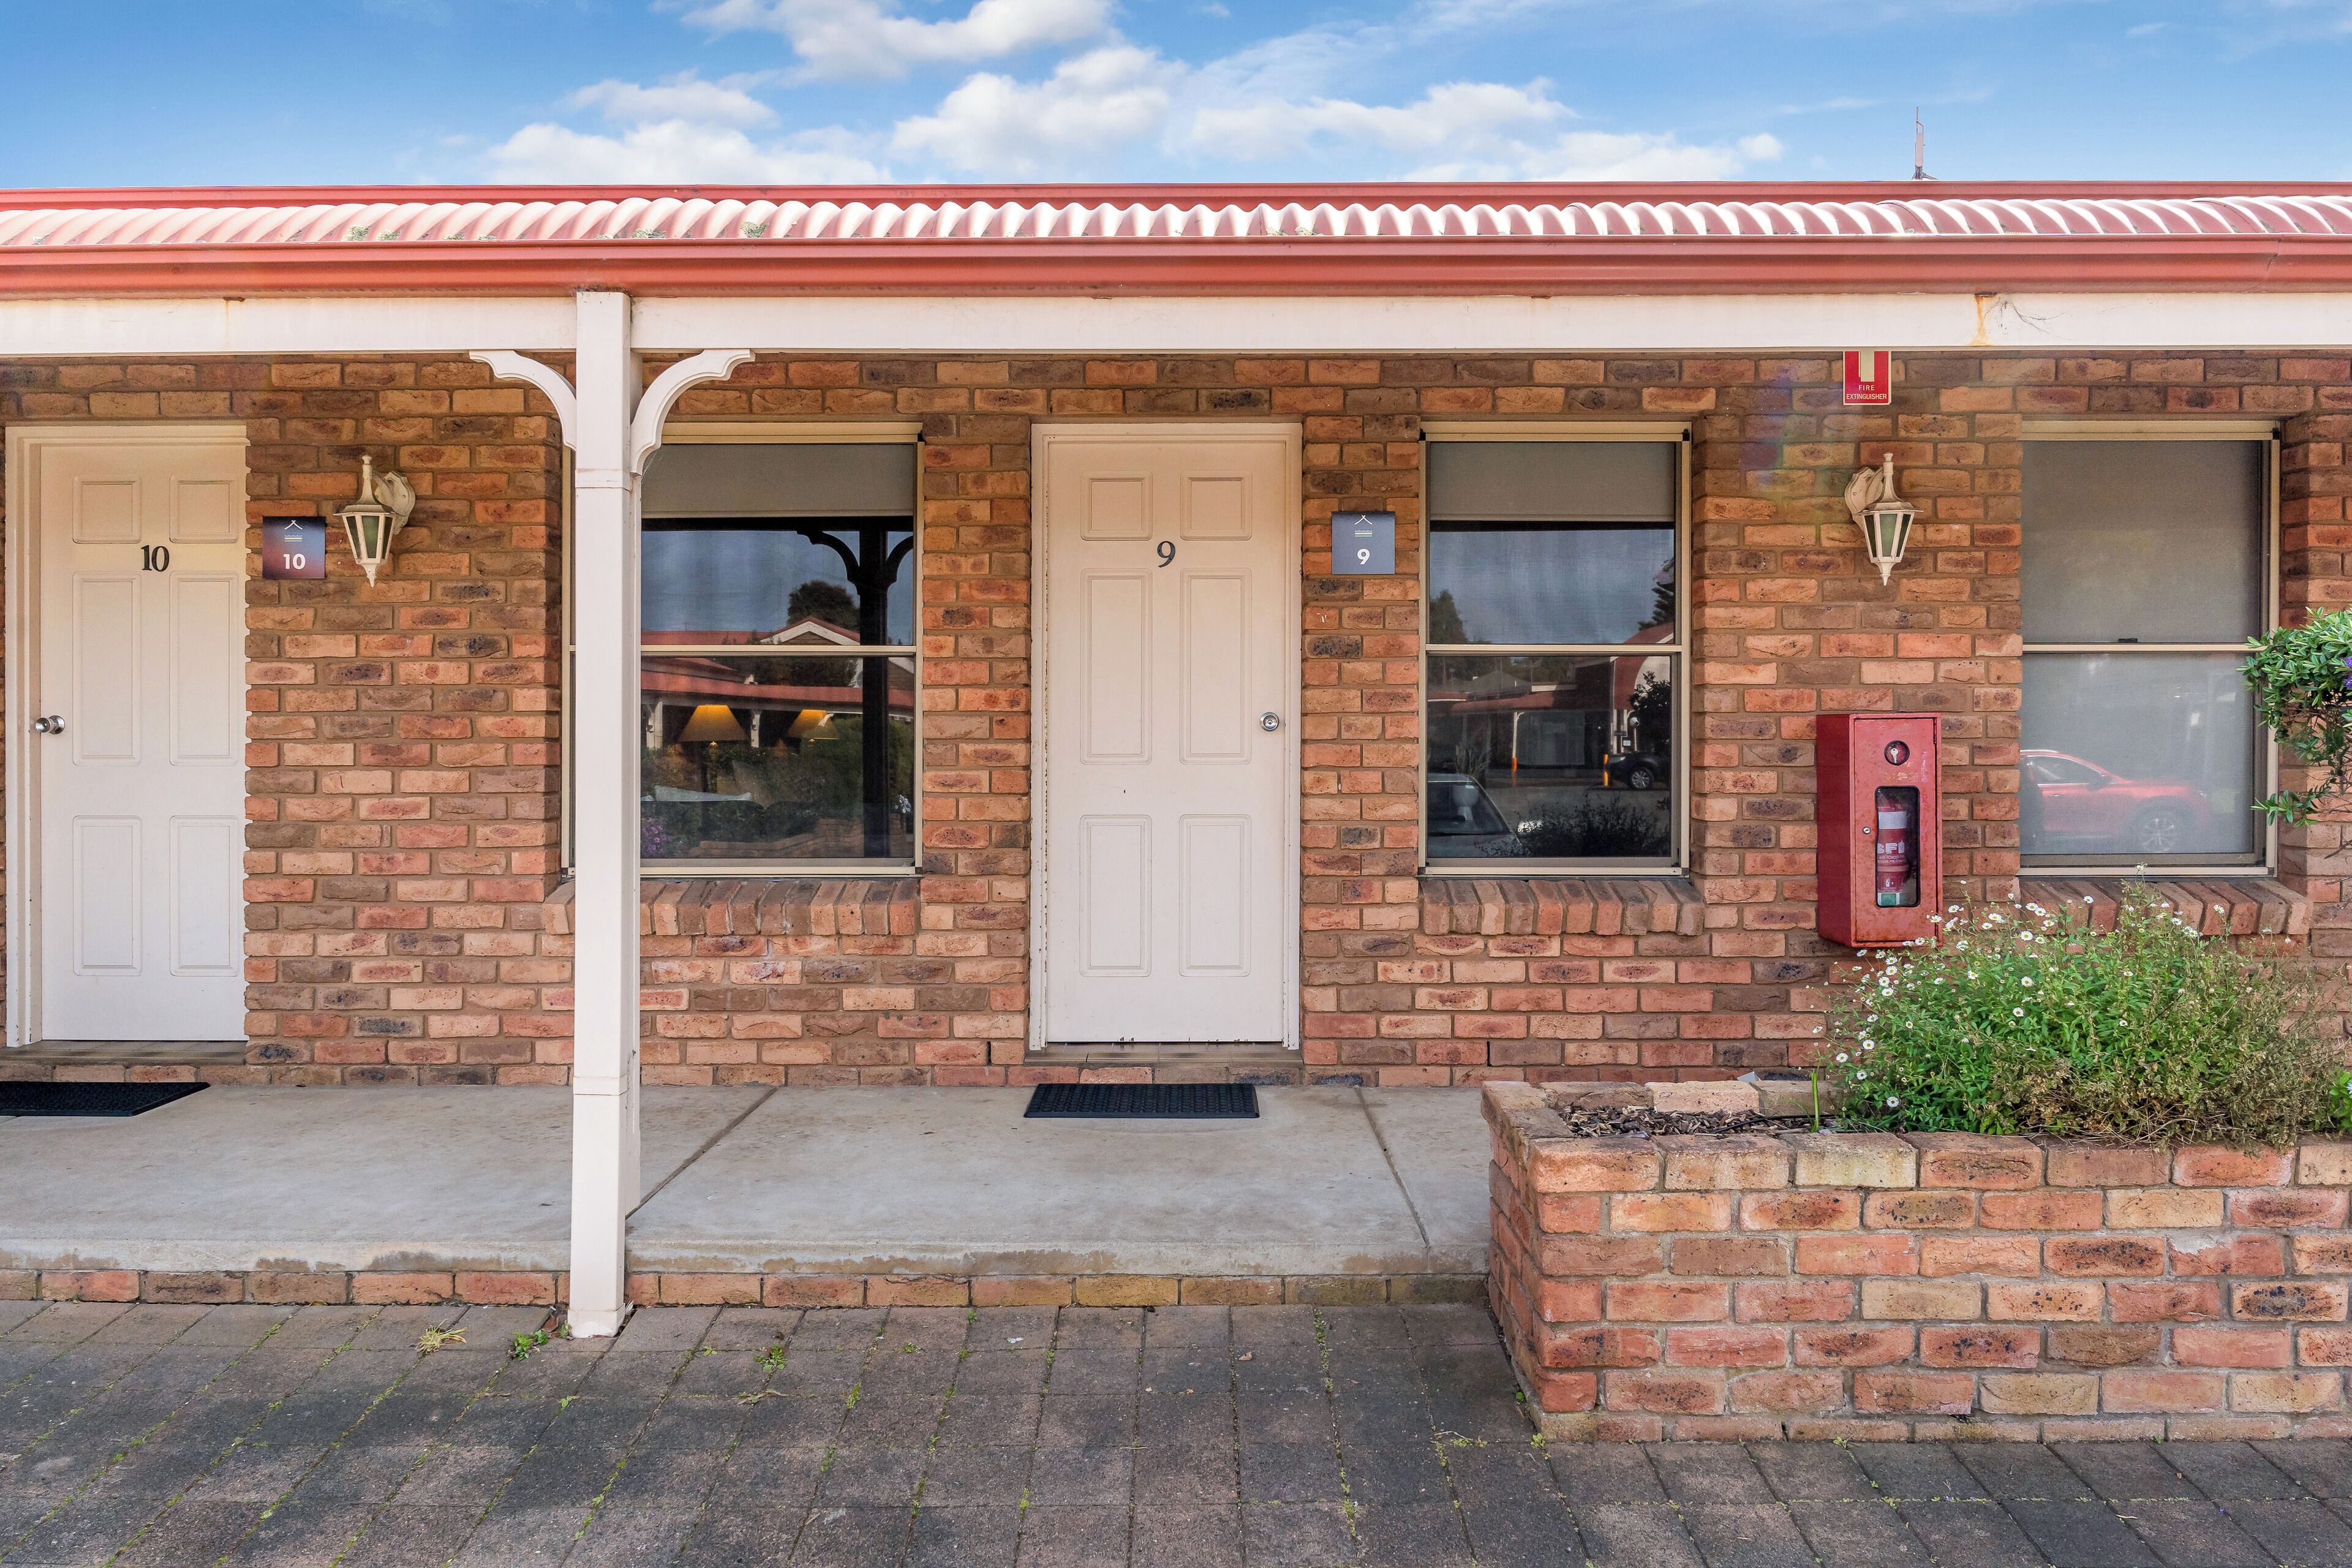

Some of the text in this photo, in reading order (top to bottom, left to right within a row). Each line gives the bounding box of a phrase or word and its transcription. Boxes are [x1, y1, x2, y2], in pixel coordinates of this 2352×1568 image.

[140, 545, 170, 572] 10
[283, 553, 306, 570] 10
[1156, 541, 1176, 568] 9
[1357, 548, 1370, 565] 9
